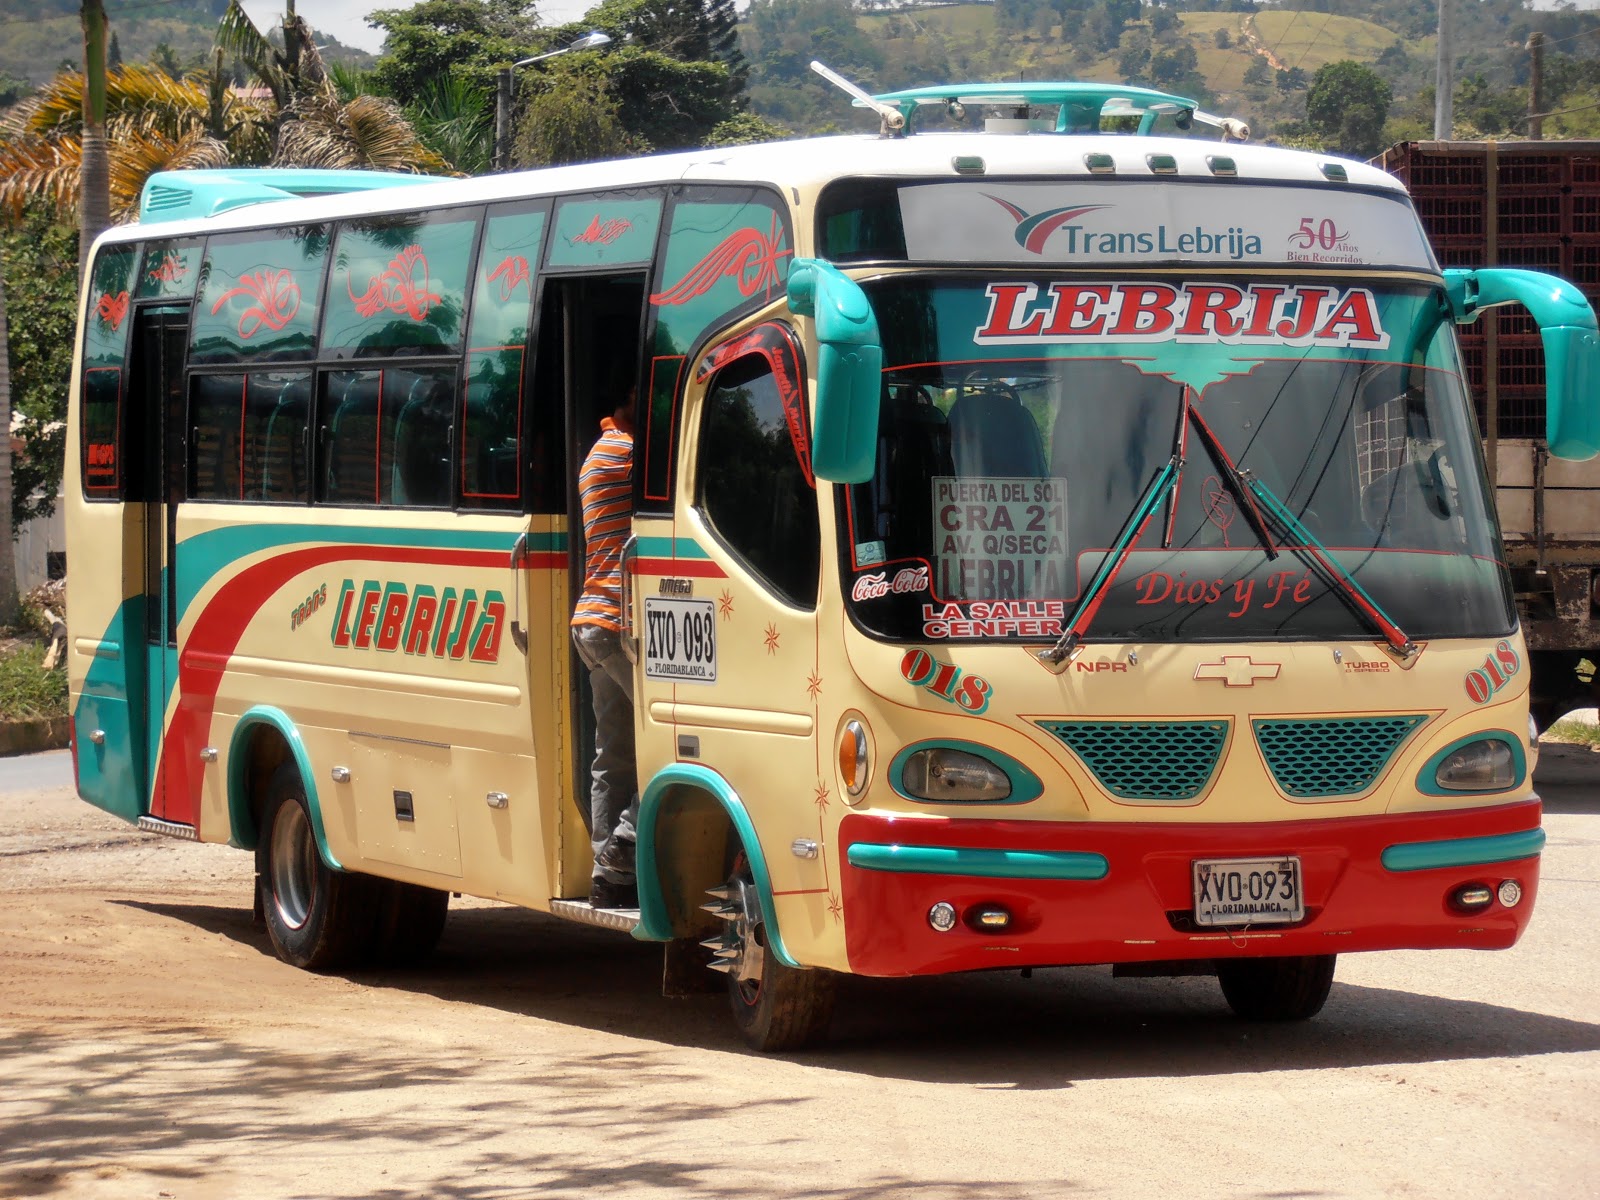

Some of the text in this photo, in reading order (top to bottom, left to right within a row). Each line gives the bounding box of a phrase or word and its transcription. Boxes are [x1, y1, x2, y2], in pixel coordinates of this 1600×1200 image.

[1299, 217, 1359, 253] 50 Años
[1287, 251, 1363, 264] Bien Recorridos
[975, 283, 1389, 347] LEBRIJA
[939, 483, 1063, 503] PUERTA DEL SOL
[939, 504, 1064, 532] CRA 21
[942, 534, 1063, 555] AV. Q/SECA
[852, 567, 928, 601] Coca-Cola
[941, 558, 1063, 600] LEBRIJA
[1135, 568, 1313, 618] Dios y Fé
[331, 578, 506, 664] LEBRIJA
[923, 602, 1064, 620] LA SALLE
[923, 620, 1064, 637] CENFER
[654, 662, 706, 677] FLORIDABLANCA
[1076, 661, 1128, 673] NPR
[1344, 661, 1390, 669] TURBO
[1464, 639, 1521, 705] 018
[900, 647, 994, 716] 018
[1211, 902, 1281, 914] FLORIDABLANCA
